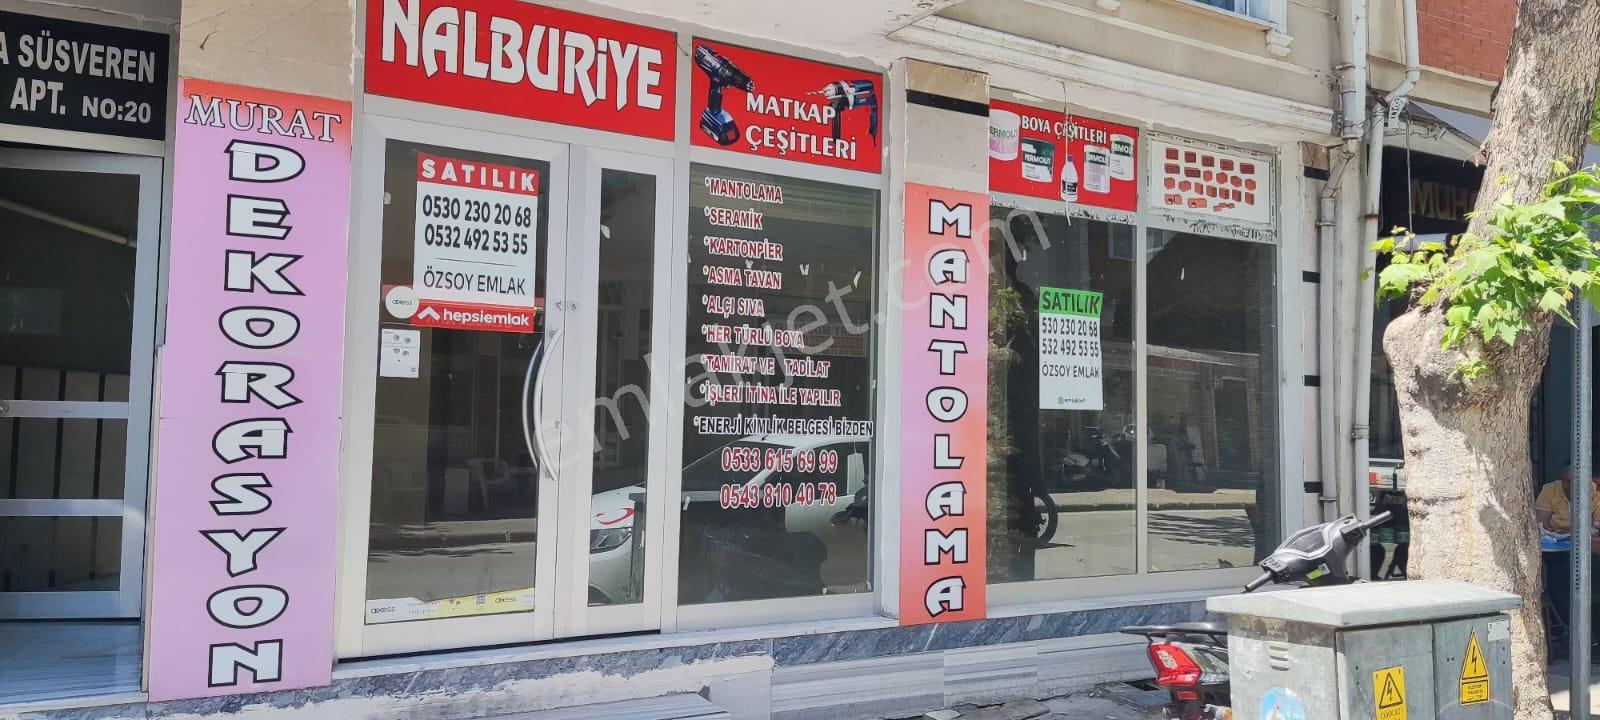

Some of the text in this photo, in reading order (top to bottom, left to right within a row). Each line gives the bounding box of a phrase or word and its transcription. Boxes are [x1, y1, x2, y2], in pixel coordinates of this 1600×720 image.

[18, 30, 156, 83] SÜSVEREN
[9, 77, 152, 124] APT. NO:20
[745, 92, 836, 125] MATKAP
[184, 94, 342, 142] MURAT
[1021, 115, 1107, 144] BOYA ÇEŞİTLERİ
[745, 125, 857, 161] ÇEŞİTLERİ
[421, 158, 536, 192] SATILIK
[422, 194, 531, 228] 0530 230 20 68
[1409, 178, 1475, 221] MUH
[424, 223, 528, 255] 0532 492 53 55
[423, 265, 526, 296] ÖZSOY EMLAK
[744, 270, 782, 289] TAVAN
[737, 297, 765, 317] SIVA
[1042, 290, 1101, 315] SATILIK
[443, 308, 529, 326] hepsiemlak
[1042, 317, 1098, 337] 530 230 20 68
[734, 324, 771, 345] TÜRLÜ
[774, 328, 805, 349] BOYA
[1042, 338, 1099, 358] 532 492 53 55
[759, 357, 775, 375] VE
[784, 356, 830, 378] TADİLAT
[1042, 361, 1099, 378] ÖZSOY EMLAK
[745, 382, 776, 404] İTİNA
[778, 383, 797, 405] İLE
[799, 387, 841, 407] YAPILIR
[924, 198, 973, 619] MANTOLAMA
[198, 139, 306, 688] DEKORASYON
[743, 413, 786, 435] KİMLİK
[786, 416, 833, 436] BELGESİ
[834, 416, 873, 437] BİZDEN
[721, 447, 838, 473] 0533 615 69 99
[720, 482, 837, 509] 0543 810 40 78
